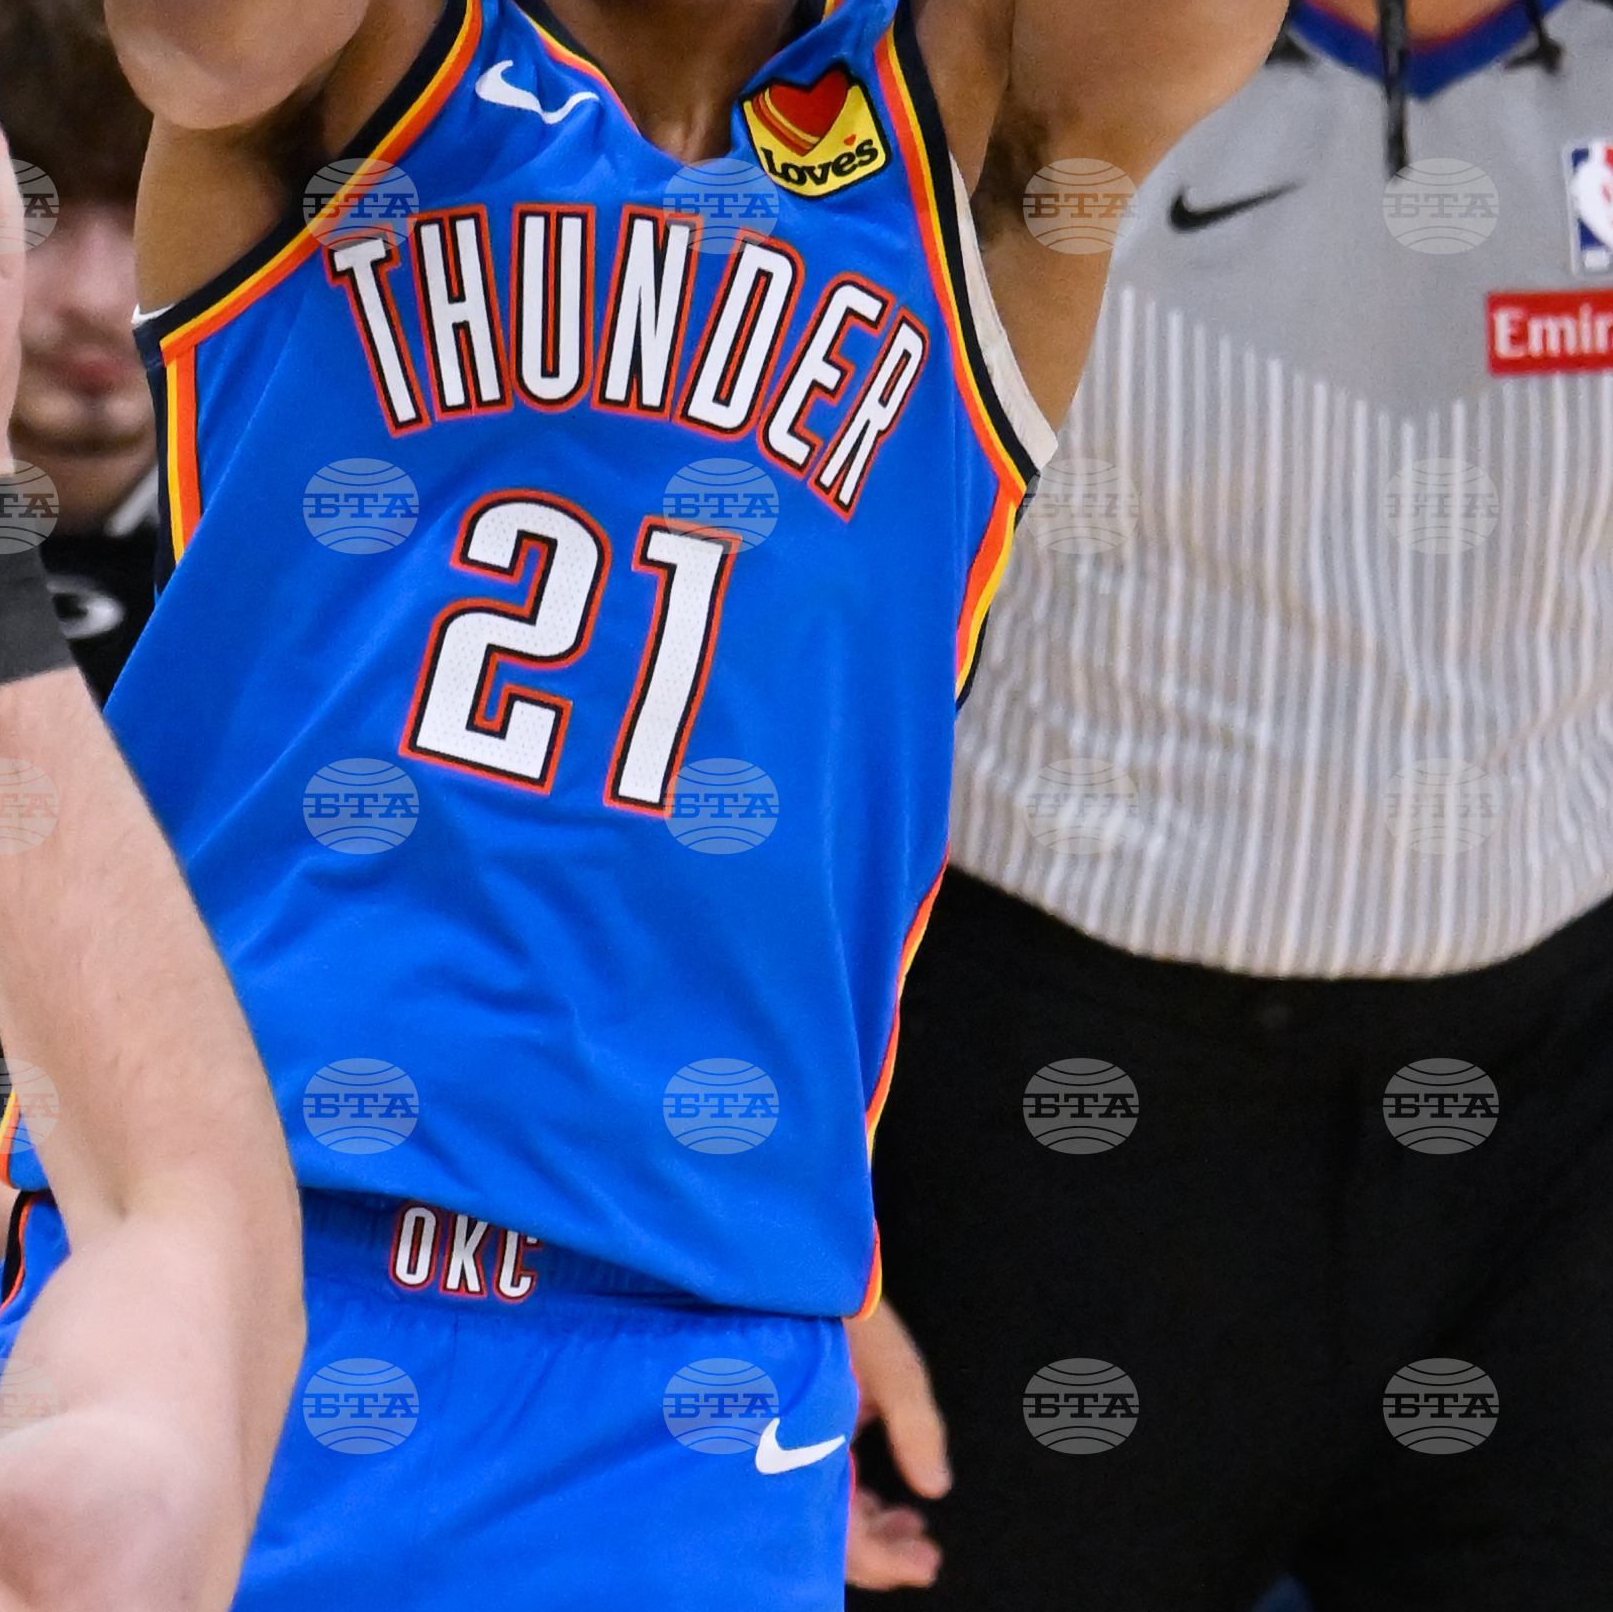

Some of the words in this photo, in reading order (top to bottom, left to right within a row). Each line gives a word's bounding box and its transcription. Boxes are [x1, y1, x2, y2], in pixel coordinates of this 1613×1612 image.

[325, 202, 929, 522] THUNDER
[400, 488, 742, 817] 21
[389, 1199, 543, 1304] OKC
